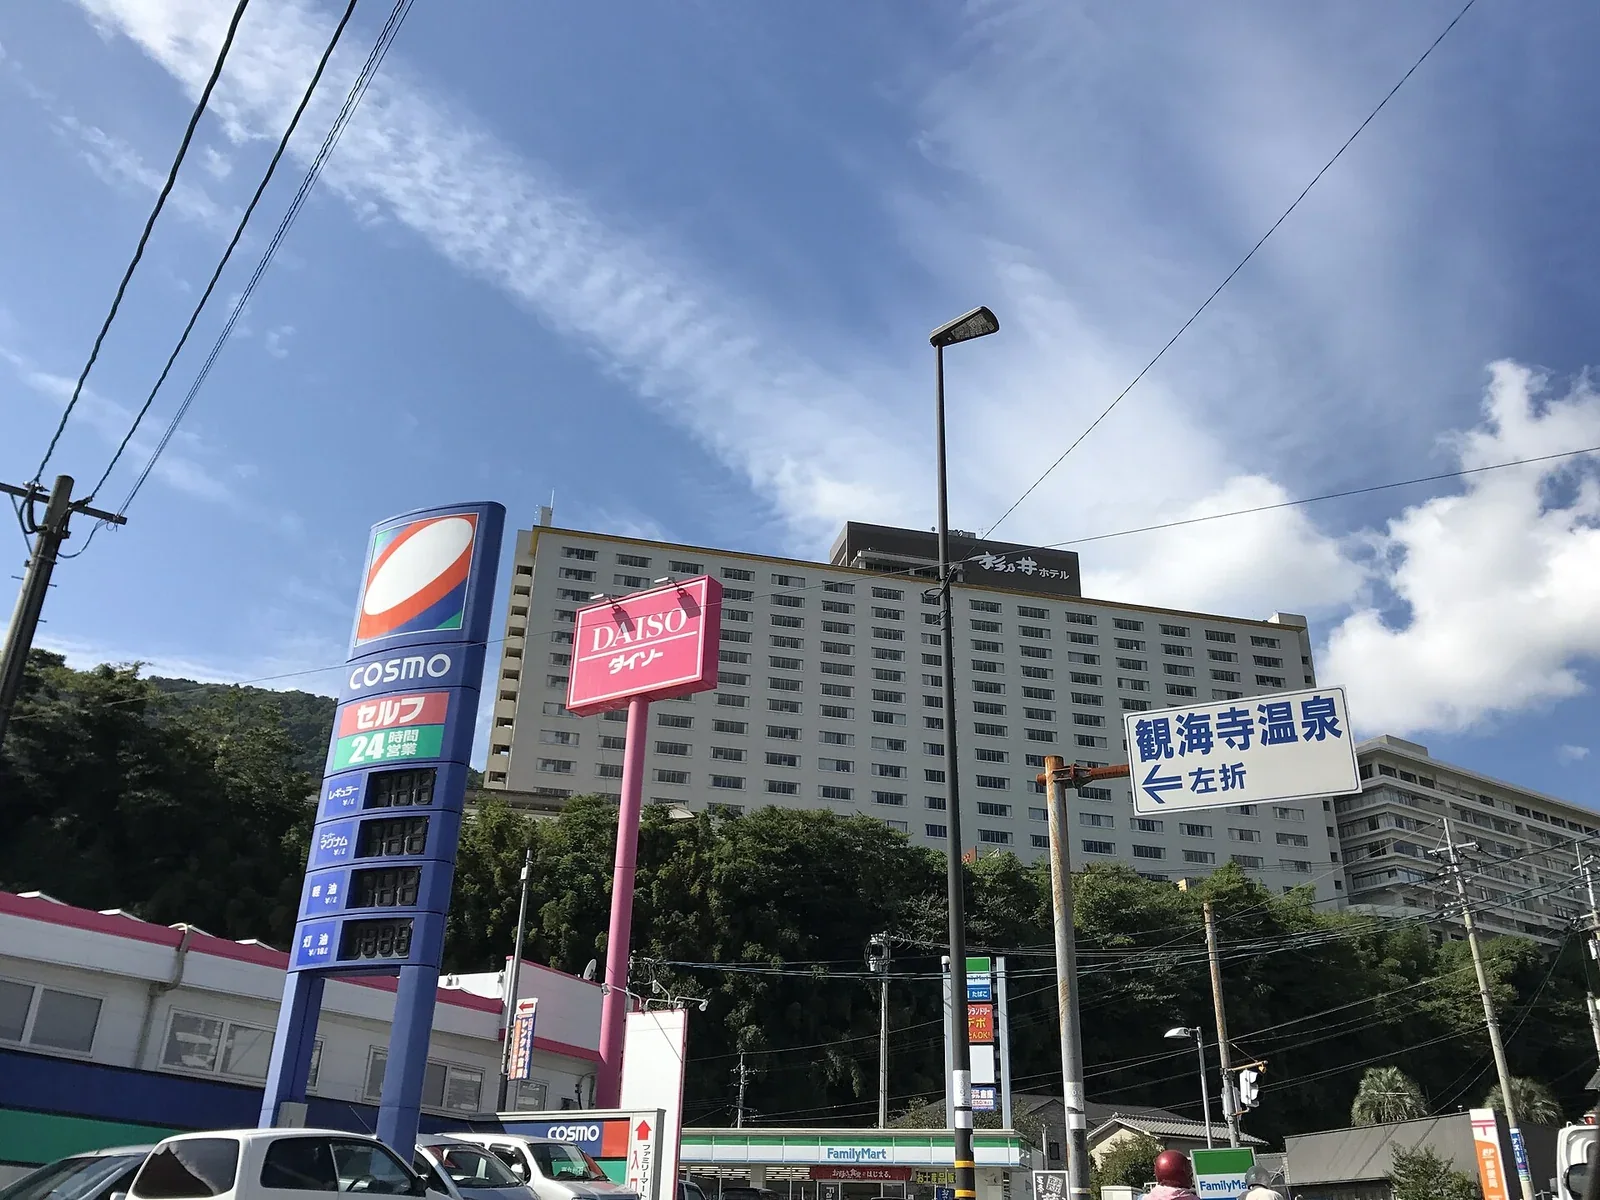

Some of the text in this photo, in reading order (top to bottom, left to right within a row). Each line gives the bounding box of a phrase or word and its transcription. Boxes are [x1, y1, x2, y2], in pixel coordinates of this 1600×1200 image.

[591, 607, 687, 652] DAISO
[608, 648, 664, 674] ダイソー
[349, 653, 451, 690] COSMO
[357, 696, 425, 729] セルフ
[1135, 695, 1343, 763] 観海寺温泉
[348, 729, 419, 763] 24 時間
[386, 743, 418, 758] 営業
[1188, 762, 1247, 794] 左折
[328, 785, 359, 800] レギュラー
[320, 836, 348, 850] マグナム
[311, 882, 337, 898] 軽油
[302, 933, 329, 948] 灯油
[971, 990, 988, 998] たばこ
[547, 1124, 600, 1142] COSMO
[827, 1147, 887, 1162] FamilyMart
[640, 1144, 651, 1200] ファミリーマート
[1200, 1179, 1248, 1193] FamilyMa
